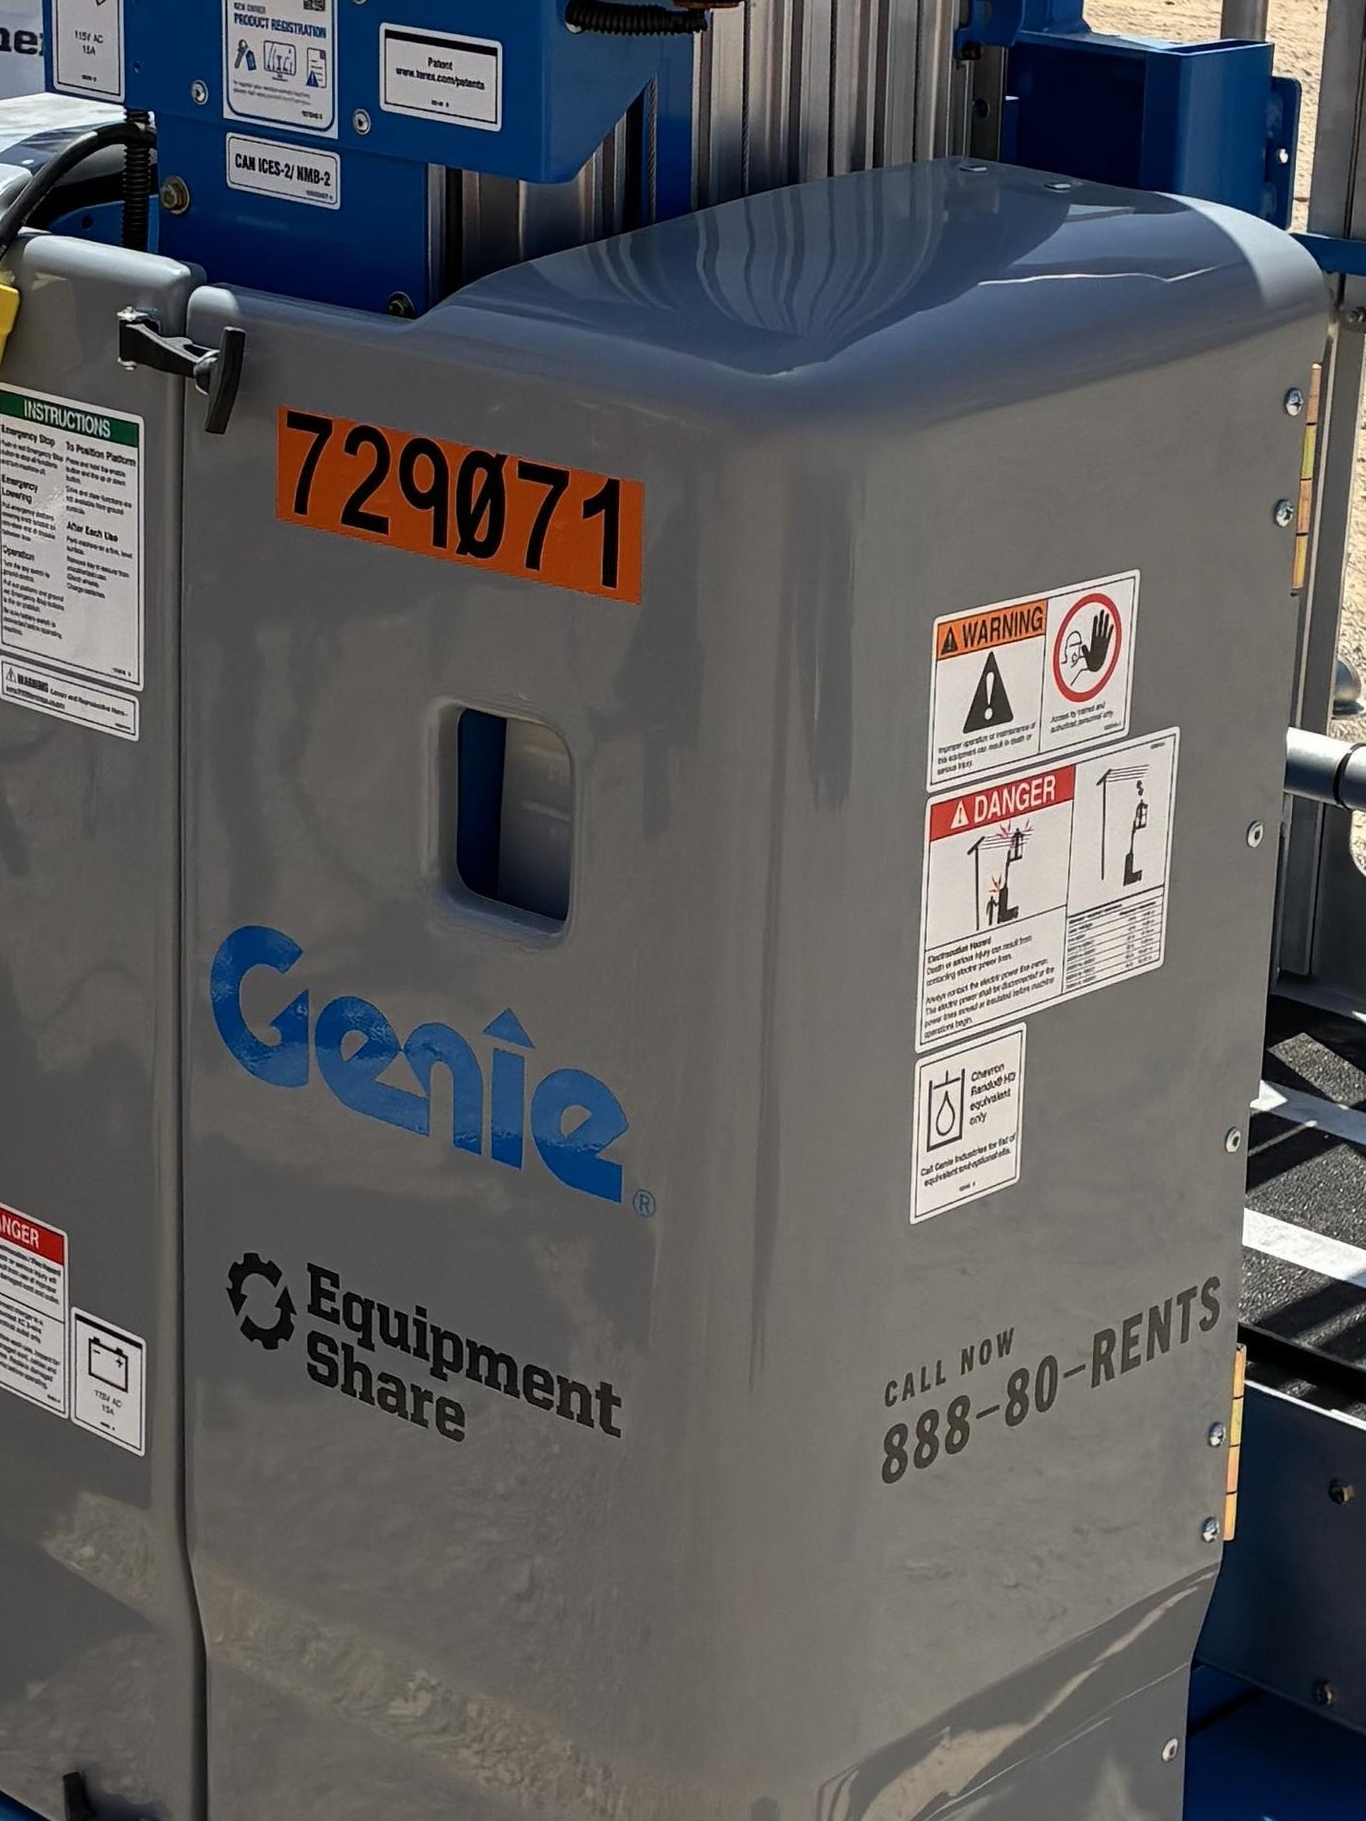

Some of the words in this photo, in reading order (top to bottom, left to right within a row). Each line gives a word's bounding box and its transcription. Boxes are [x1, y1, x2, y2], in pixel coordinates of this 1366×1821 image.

[234, 12, 270, 30] PRODUCT
[271, 18, 327, 40] REGISTRATION
[427, 57, 453, 70] Patent
[235, 153, 256, 172] CAN
[296, 164, 332, 187] NMB-2
[24, 400, 111, 438] INSTRUCTIONS
[285, 410, 622, 591] 729071
[962, 606, 1044, 648] WARNING
[973, 775, 1056, 826] DANGER
[209, 924, 630, 1204] Genie
[970, 1060, 1005, 1083] Chevron
[968, 1109, 987, 1128] only
[969, 1086, 1011, 1113] equivalent
[306, 1261, 623, 1439] Equipment
[884, 1351, 948, 1407] CALL
[960, 1327, 1016, 1376] NOW
[306, 1338, 467, 1443] Share
[880, 1275, 1222, 1485] 888-80-RENTS
